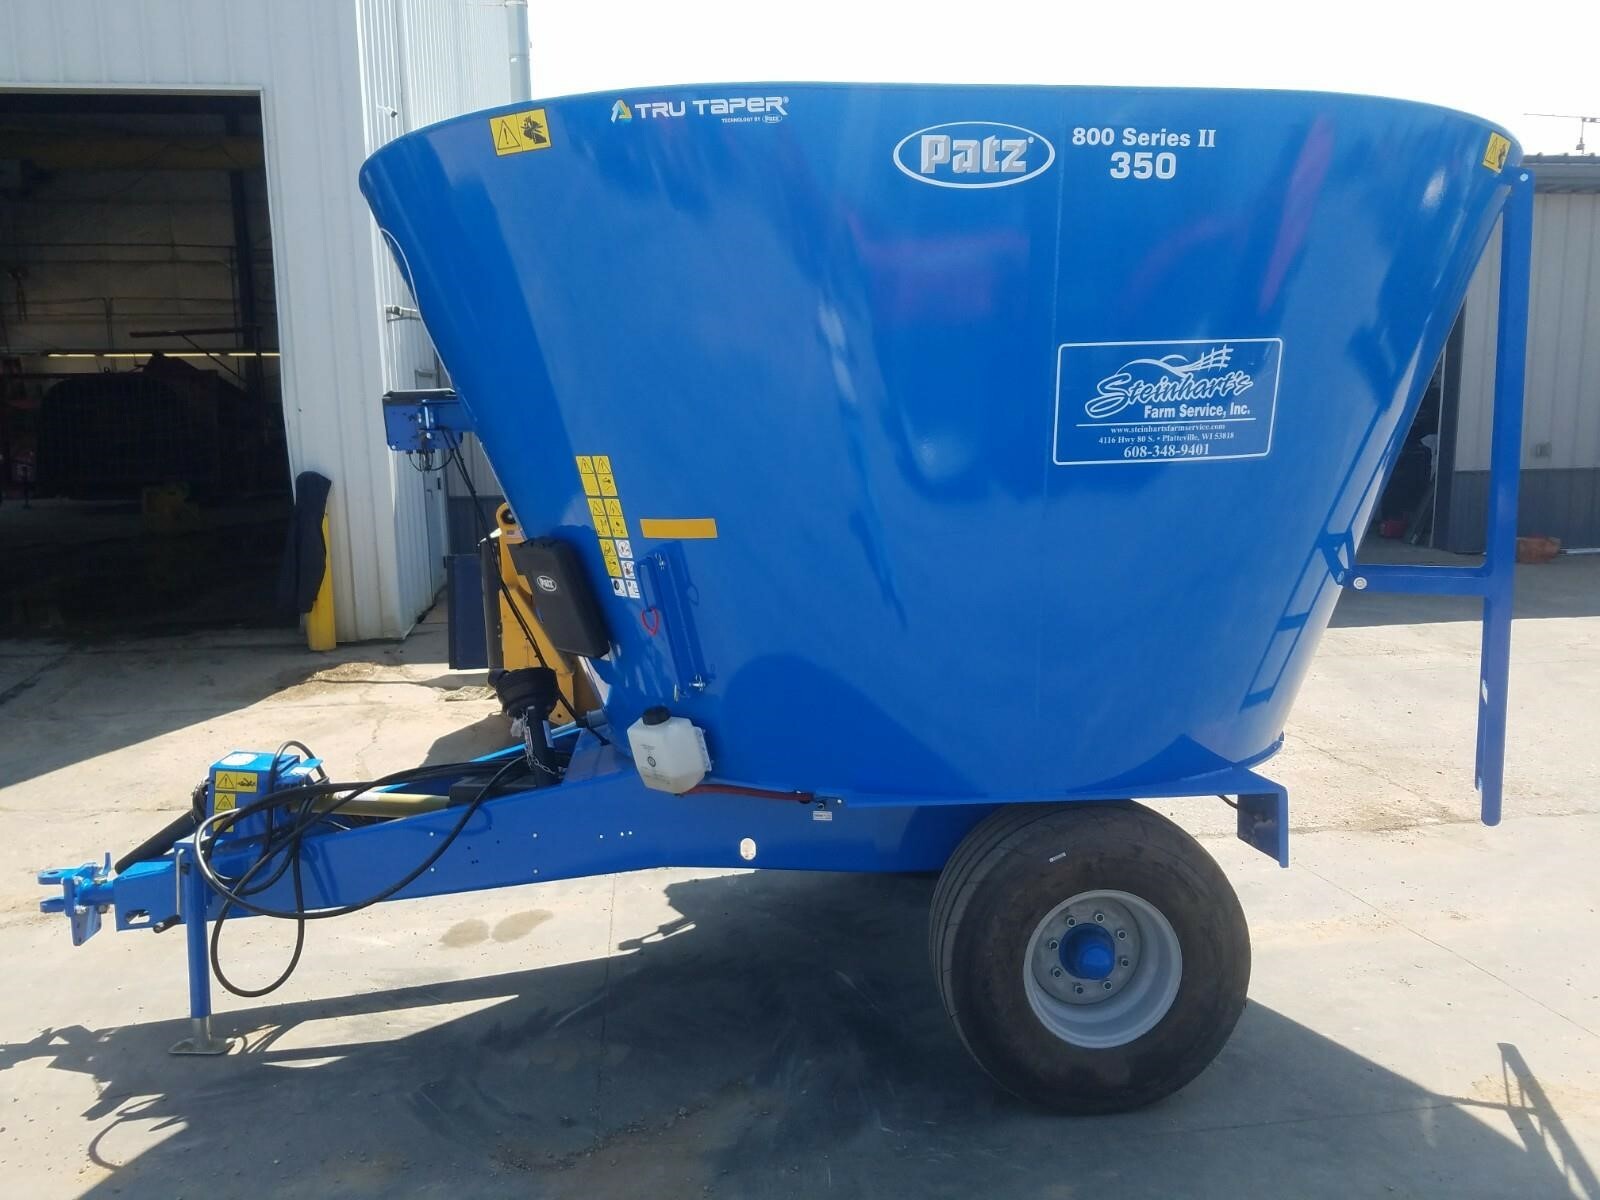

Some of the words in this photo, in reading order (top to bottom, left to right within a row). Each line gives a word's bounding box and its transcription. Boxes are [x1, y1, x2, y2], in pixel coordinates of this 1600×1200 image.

[635, 102, 685, 119] TRU
[1072, 127, 1114, 146] 800
[1122, 127, 1190, 147] Series
[1198, 129, 1216, 148] II
[920, 135, 1027, 174] Patz
[1110, 152, 1176, 180] 350
[1144, 404, 1175, 419] Farm
[1179, 403, 1226, 418] Service,
[1229, 402, 1250, 416] Inc.
[1098, 436, 1116, 444] 4116
[1118, 436, 1135, 445] Hwy
[1162, 433, 1200, 442] Platteville,
[1214, 431, 1235, 439] 53818
[1123, 443, 1210, 458] 608-348-9401
